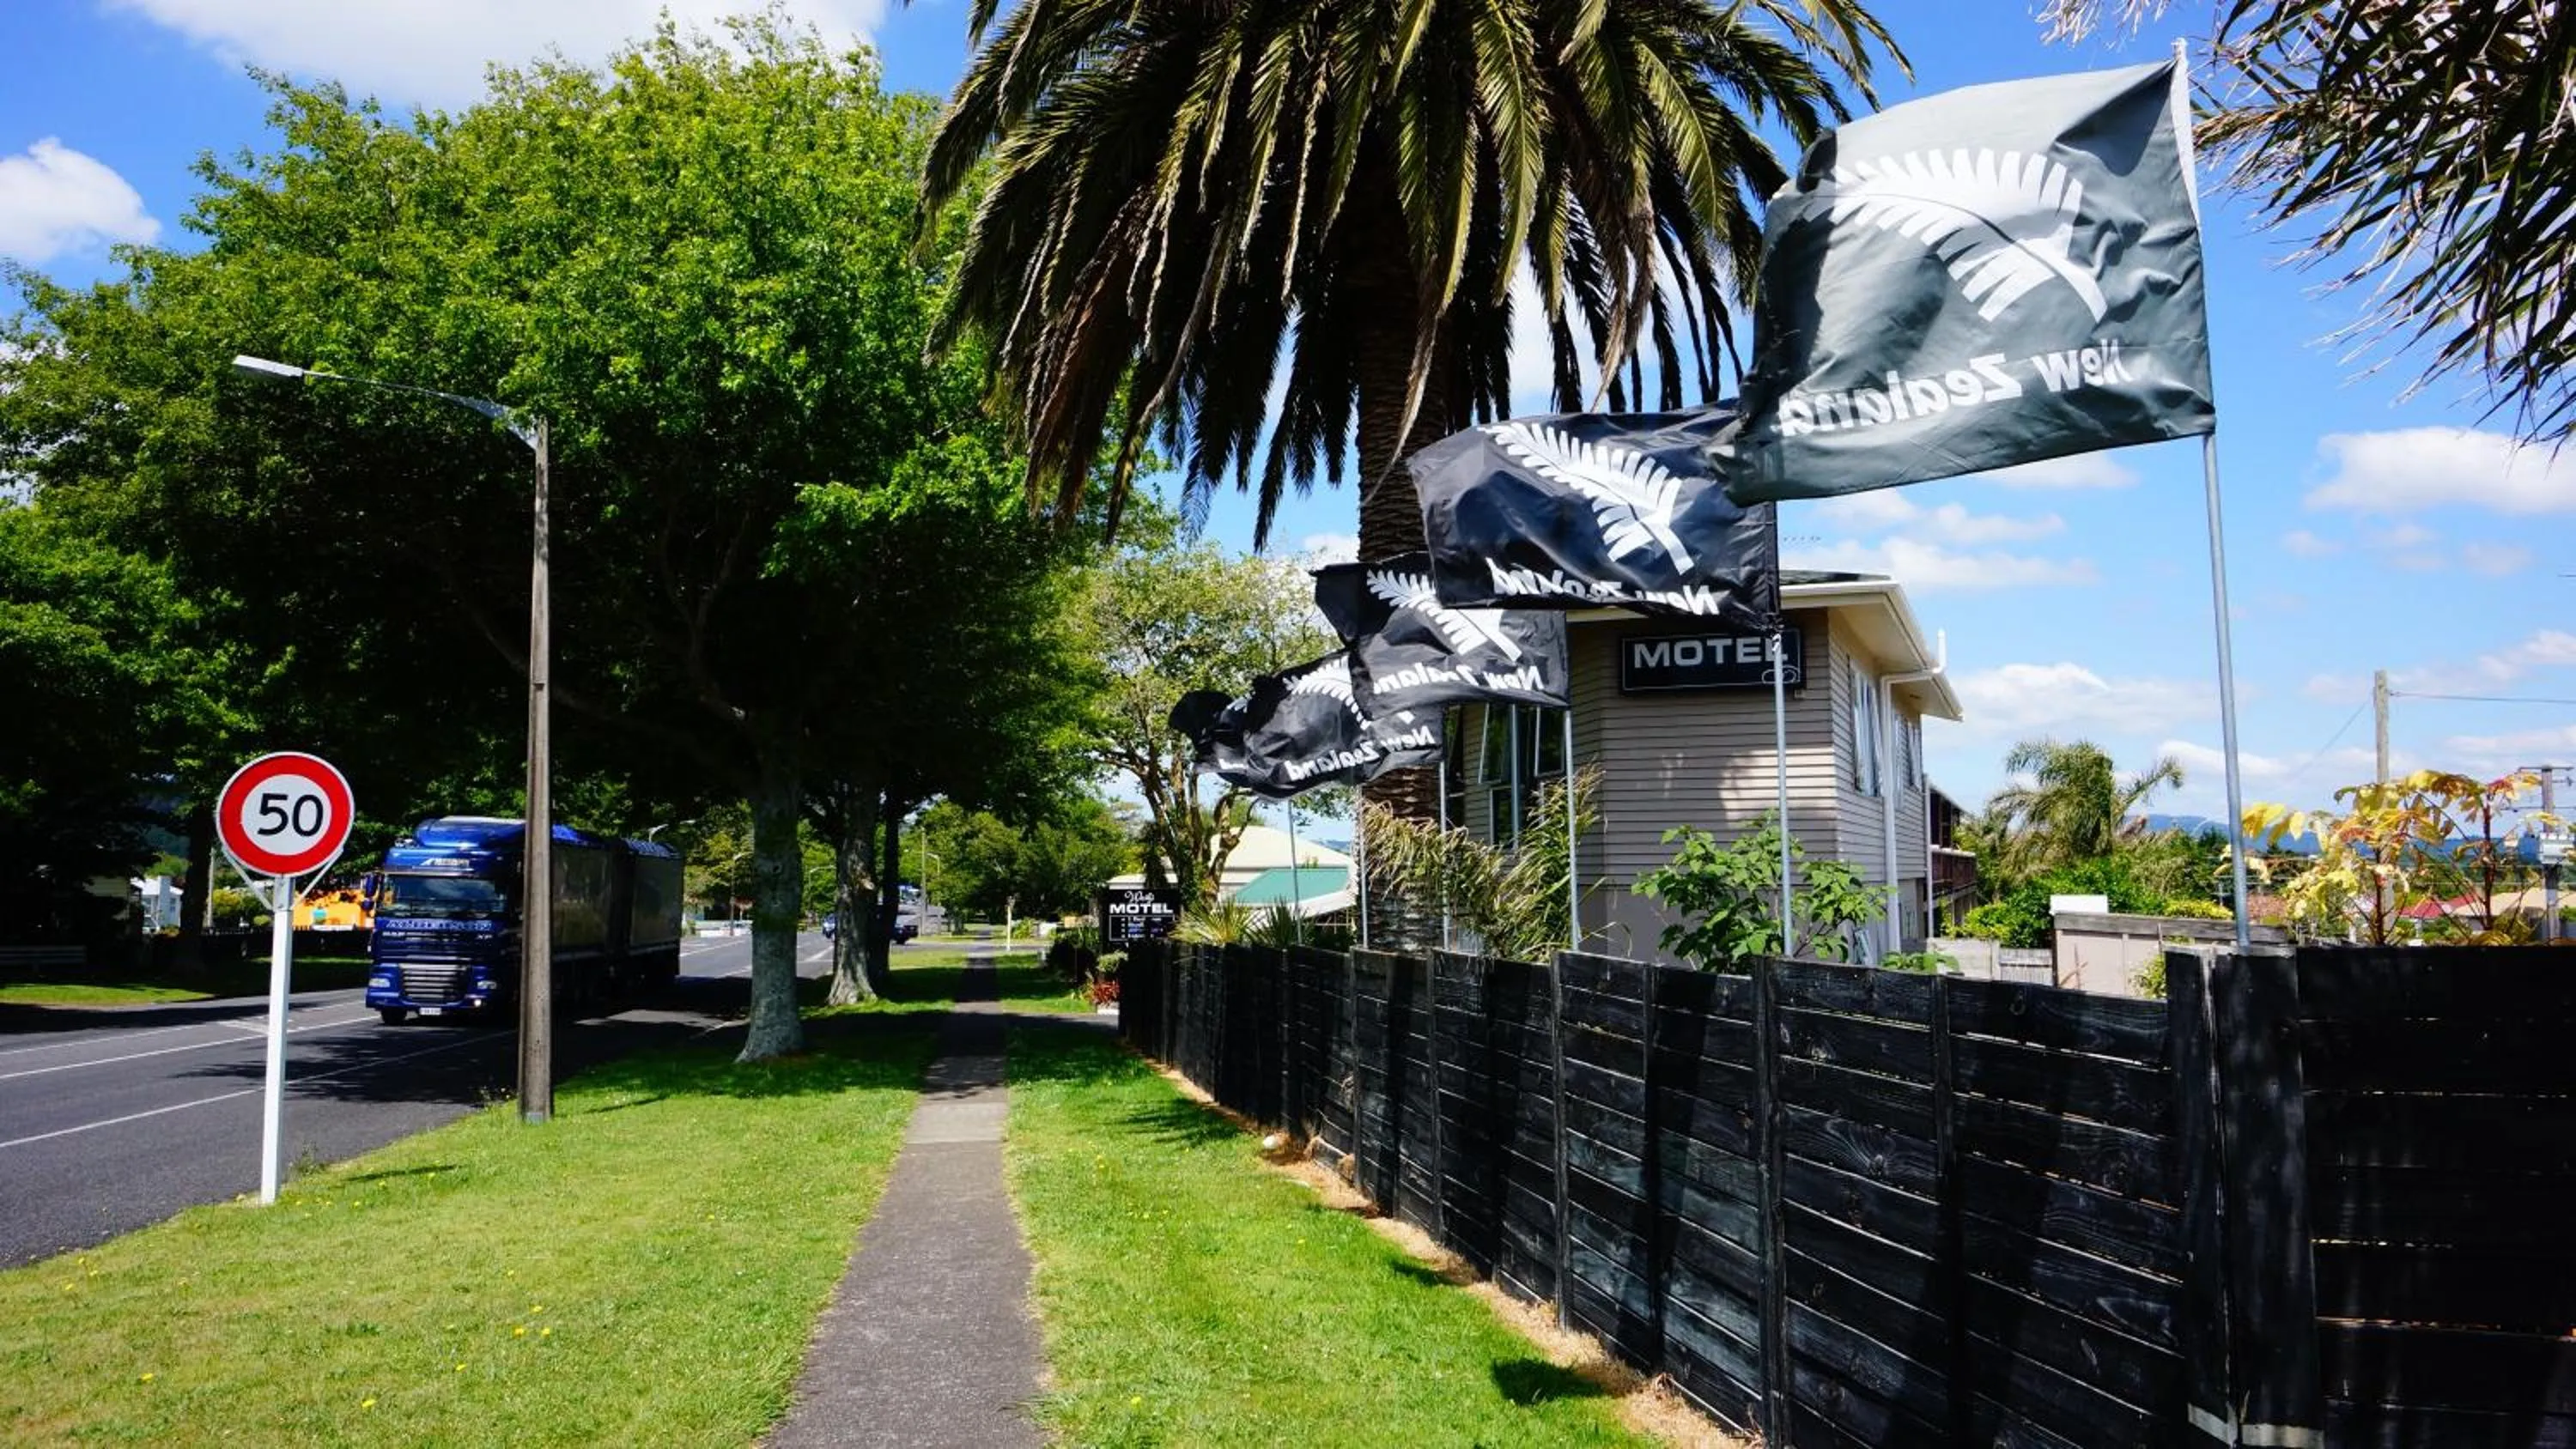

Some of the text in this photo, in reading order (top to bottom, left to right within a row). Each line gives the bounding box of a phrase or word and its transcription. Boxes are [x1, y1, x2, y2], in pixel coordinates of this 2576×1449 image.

[1634, 636, 1789, 669] MOTEL
[257, 792, 324, 837] 50
[1109, 902, 1173, 914] MOTEL
